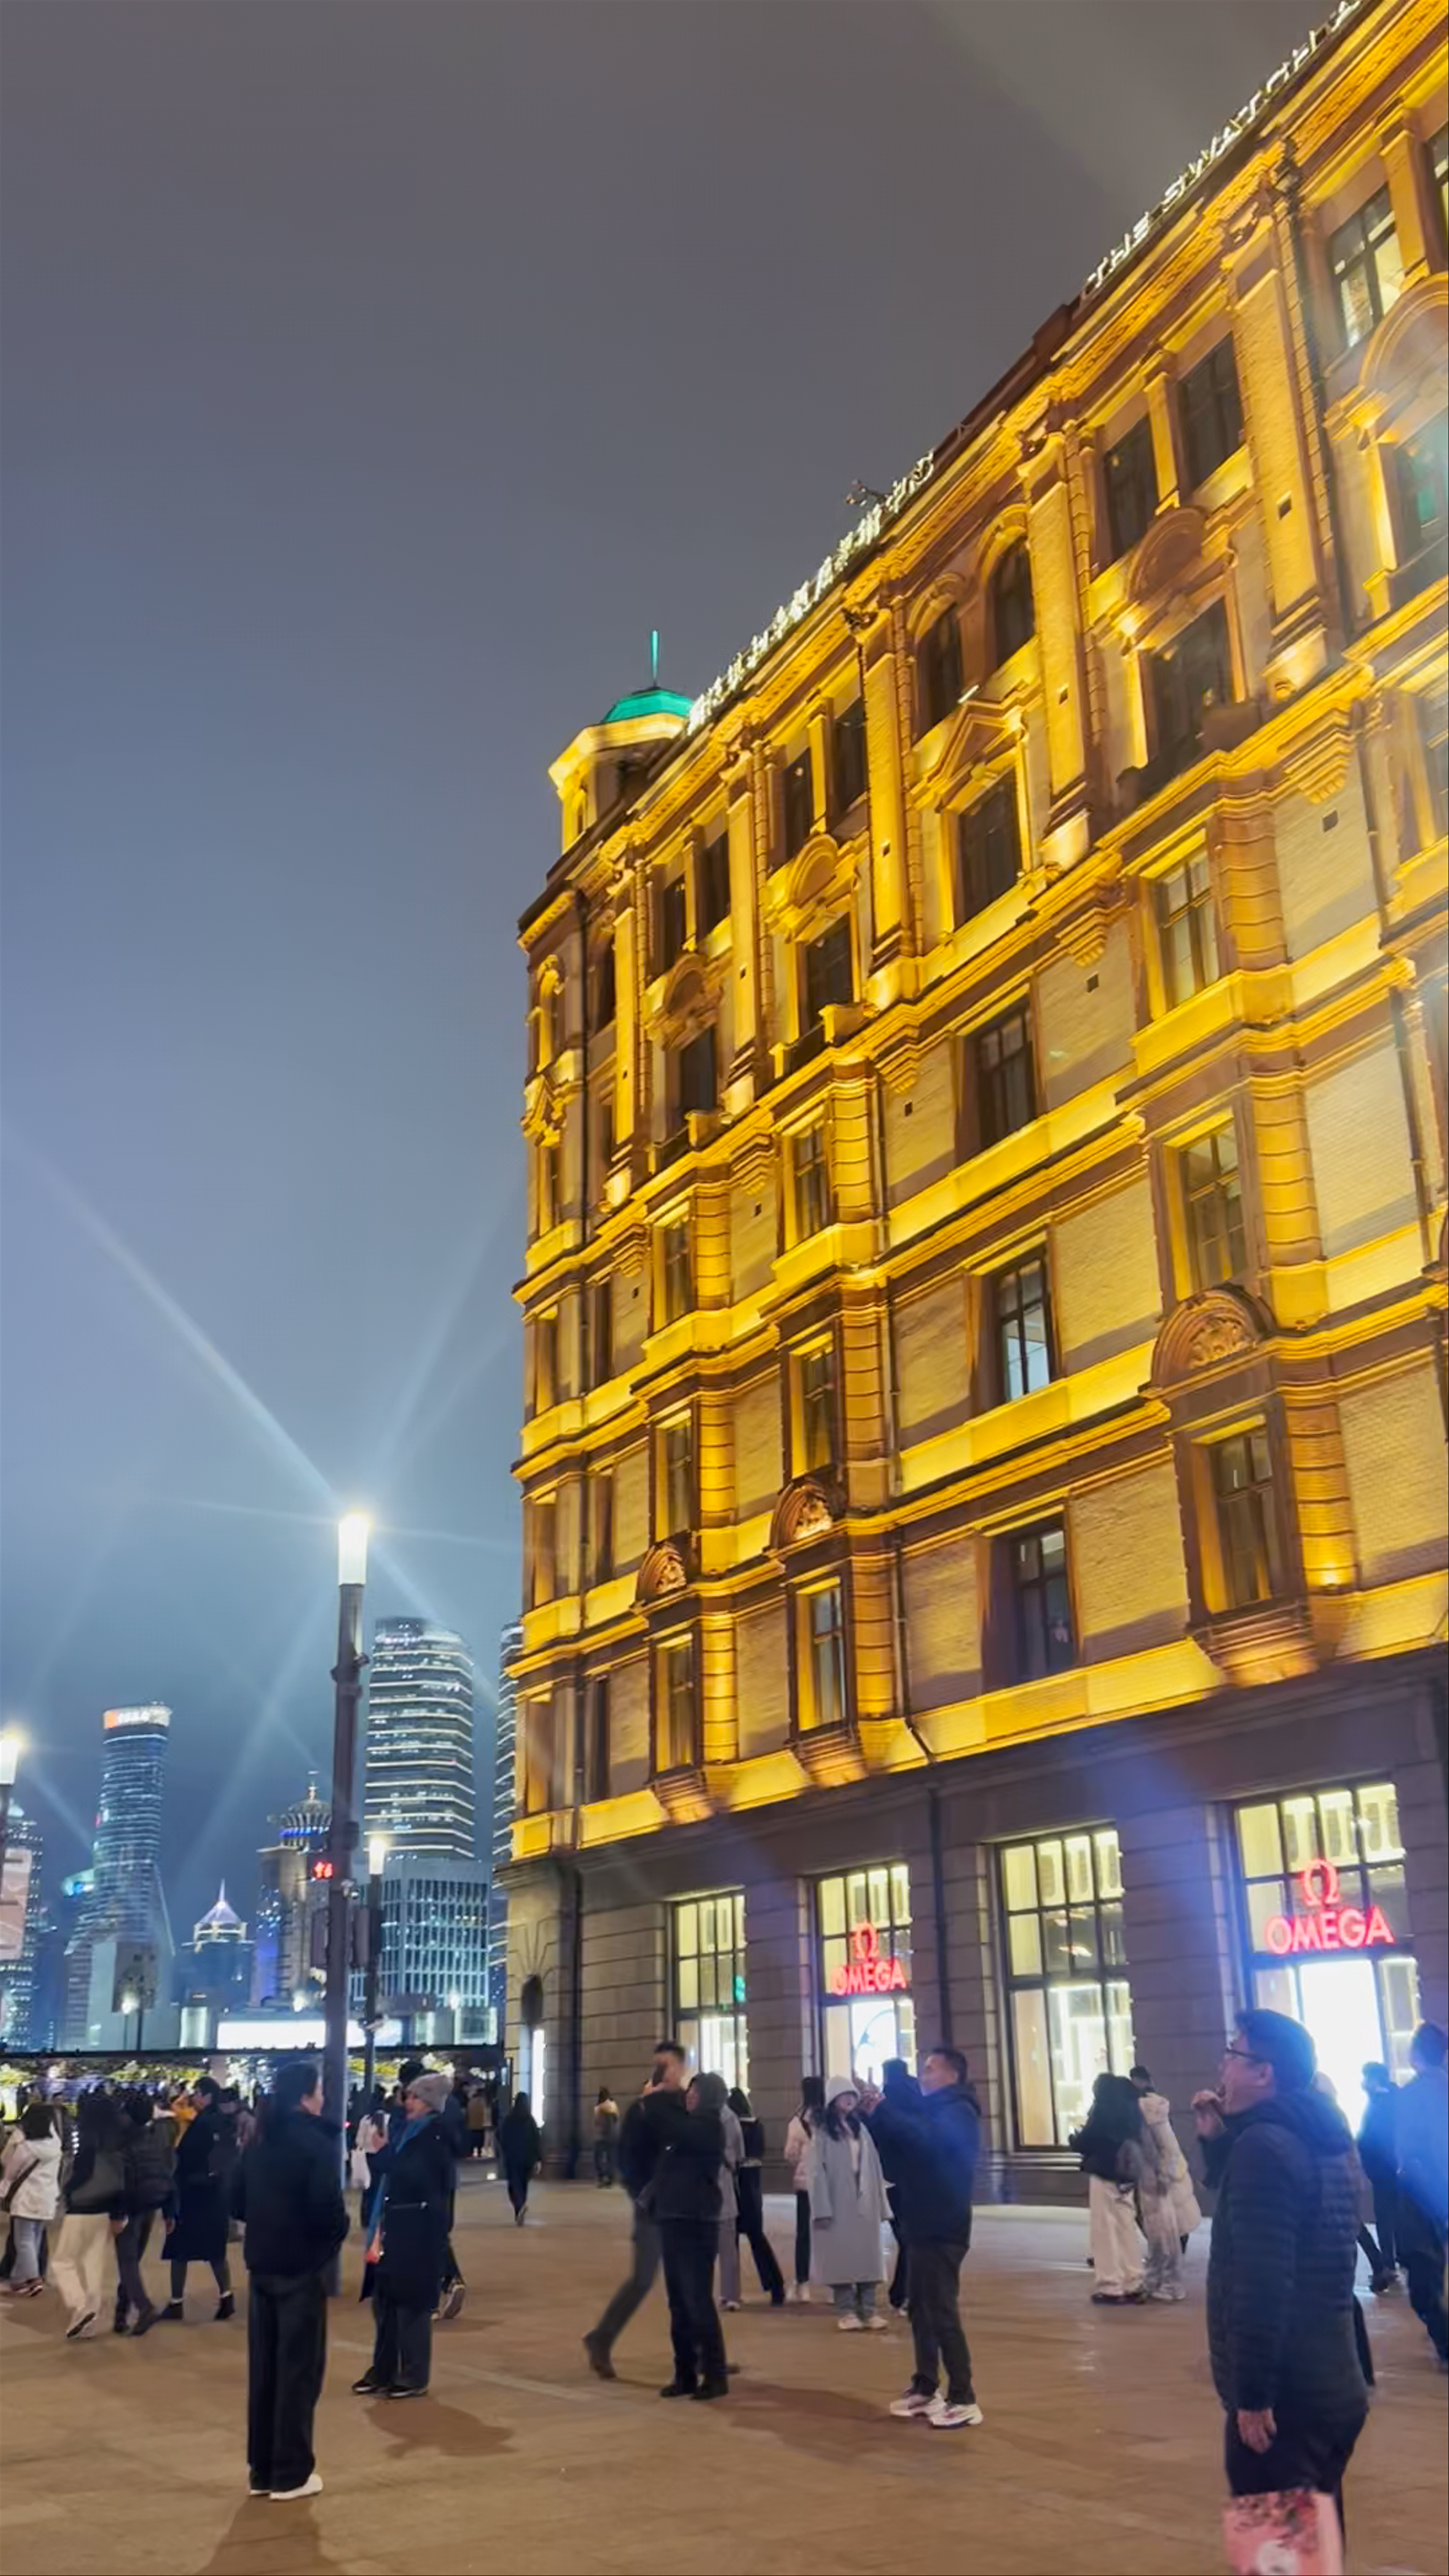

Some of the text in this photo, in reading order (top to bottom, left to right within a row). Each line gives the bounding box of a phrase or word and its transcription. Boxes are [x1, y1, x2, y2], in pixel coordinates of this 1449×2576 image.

[1087, 211, 1149, 289] THE
[1161, 30, 1317, 213] SWATCH
[1266, 1906, 1395, 1954] OMEGA
[831, 1959, 906, 1995] OMEGA
